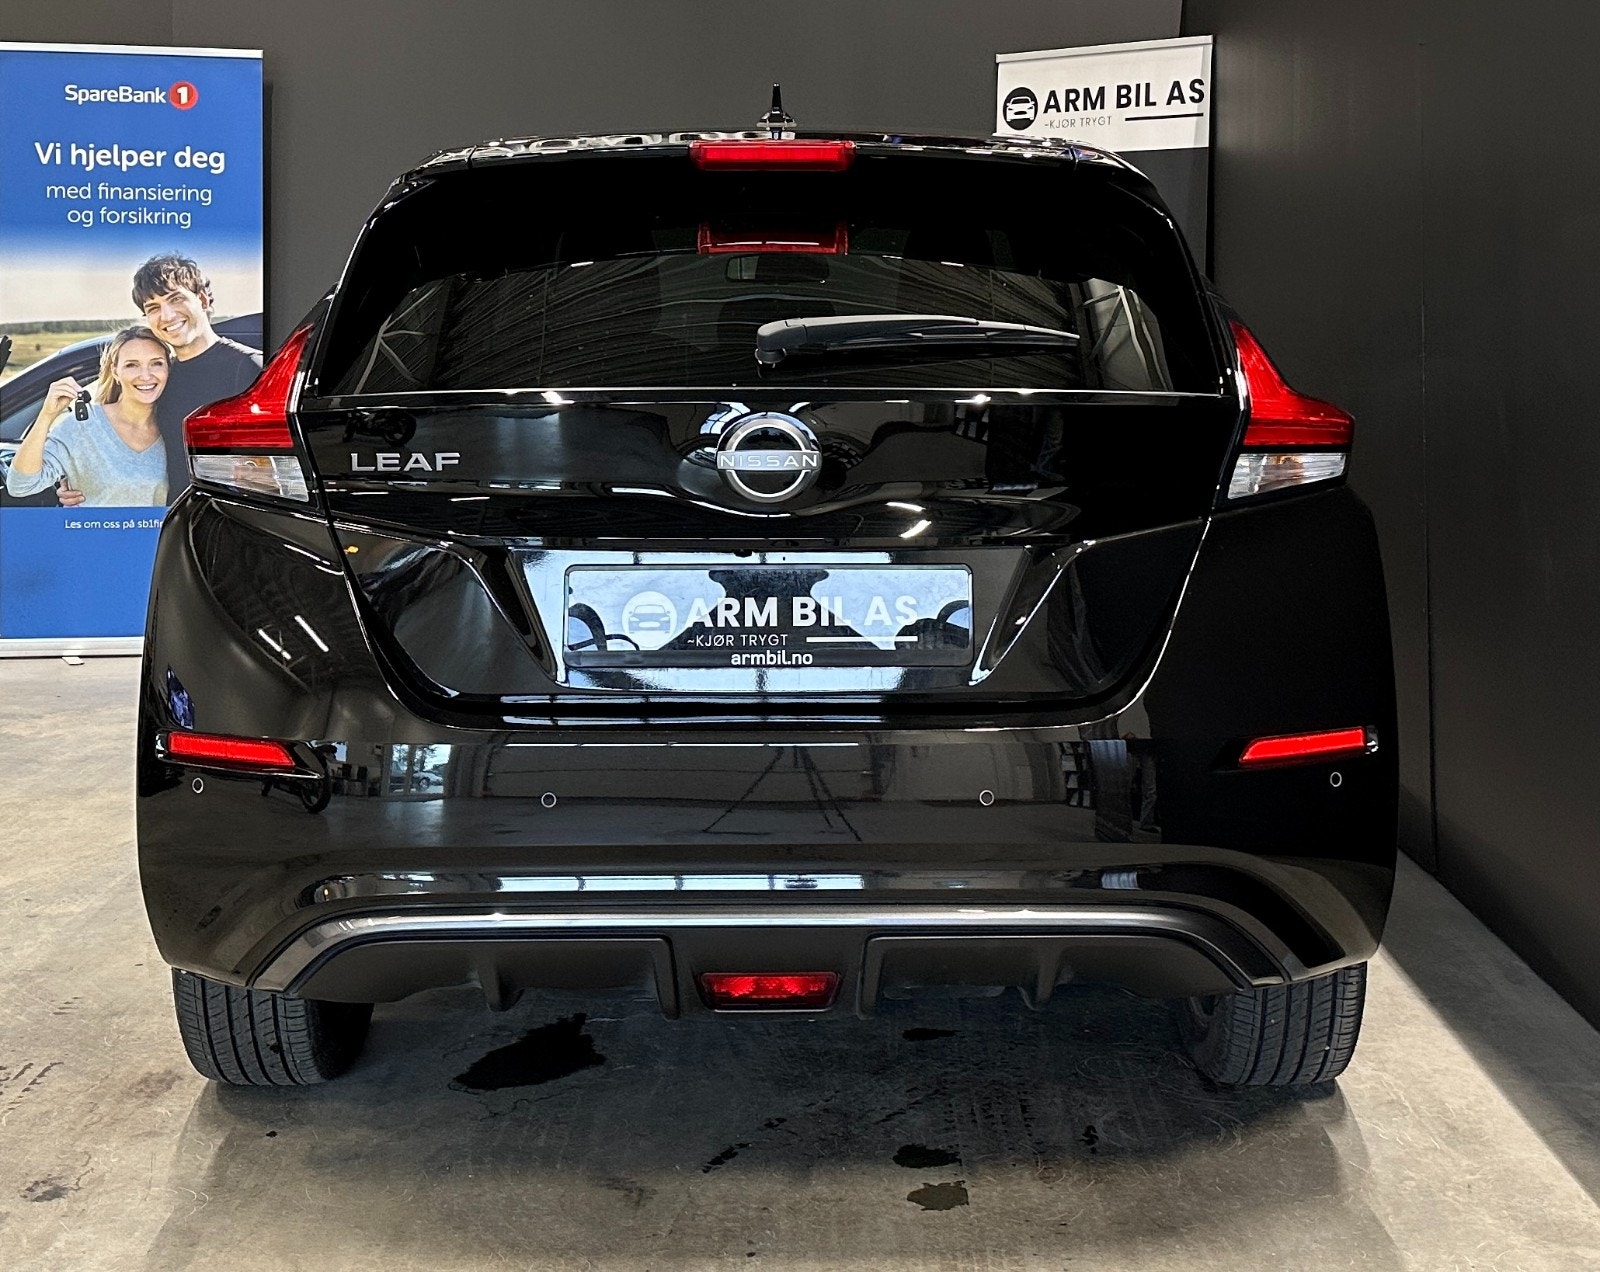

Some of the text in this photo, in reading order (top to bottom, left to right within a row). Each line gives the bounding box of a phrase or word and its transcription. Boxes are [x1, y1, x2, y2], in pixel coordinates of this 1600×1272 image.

[64, 84, 188, 105] SpareBank 1
[1043, 78, 1205, 114] ARM BIL AS
[1080, 116, 1112, 127] TRYGT
[35, 142, 226, 175] Vi hjelper deg
[46, 183, 212, 206] med finansiering
[67, 207, 192, 229] og forsikring
[350, 452, 461, 472] LEAF
[718, 454, 819, 469] NISSAN
[65, 520, 81, 529] Les
[84, 521, 101, 529] om
[103, 521, 120, 529] oss
[123, 519, 135, 530] på
[685, 595, 918, 628] ARM BIL AS
[740, 634, 788, 646] TRYGT
[730, 649, 814, 666] armbil.no
